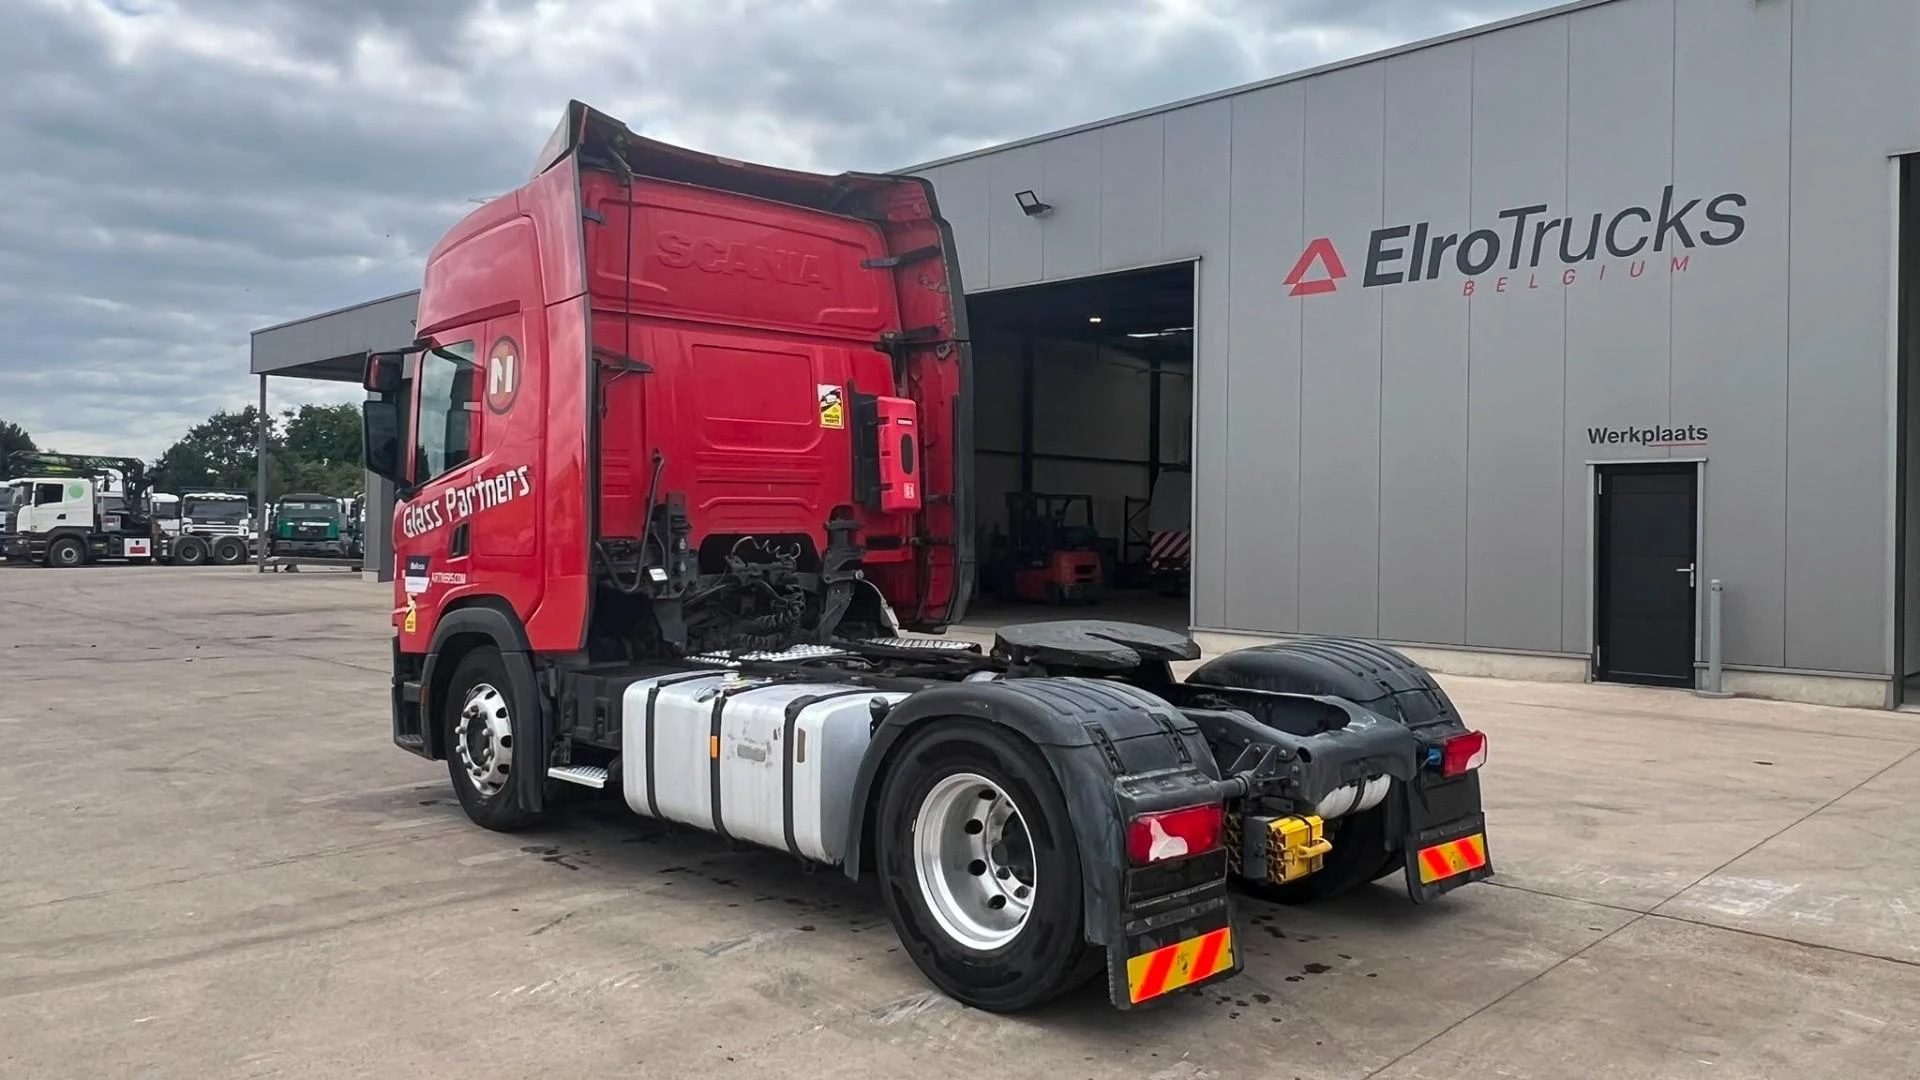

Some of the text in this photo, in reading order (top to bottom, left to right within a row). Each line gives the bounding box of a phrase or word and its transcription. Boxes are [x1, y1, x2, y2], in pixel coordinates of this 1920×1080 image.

[657, 230, 831, 291] SCANIA
[1362, 184, 1747, 288] ElroTrucks
[1462, 254, 1690, 297] BELGIUM
[1587, 424, 1709, 446] Werkplaats
[403, 465, 530, 538] Glass Partners
